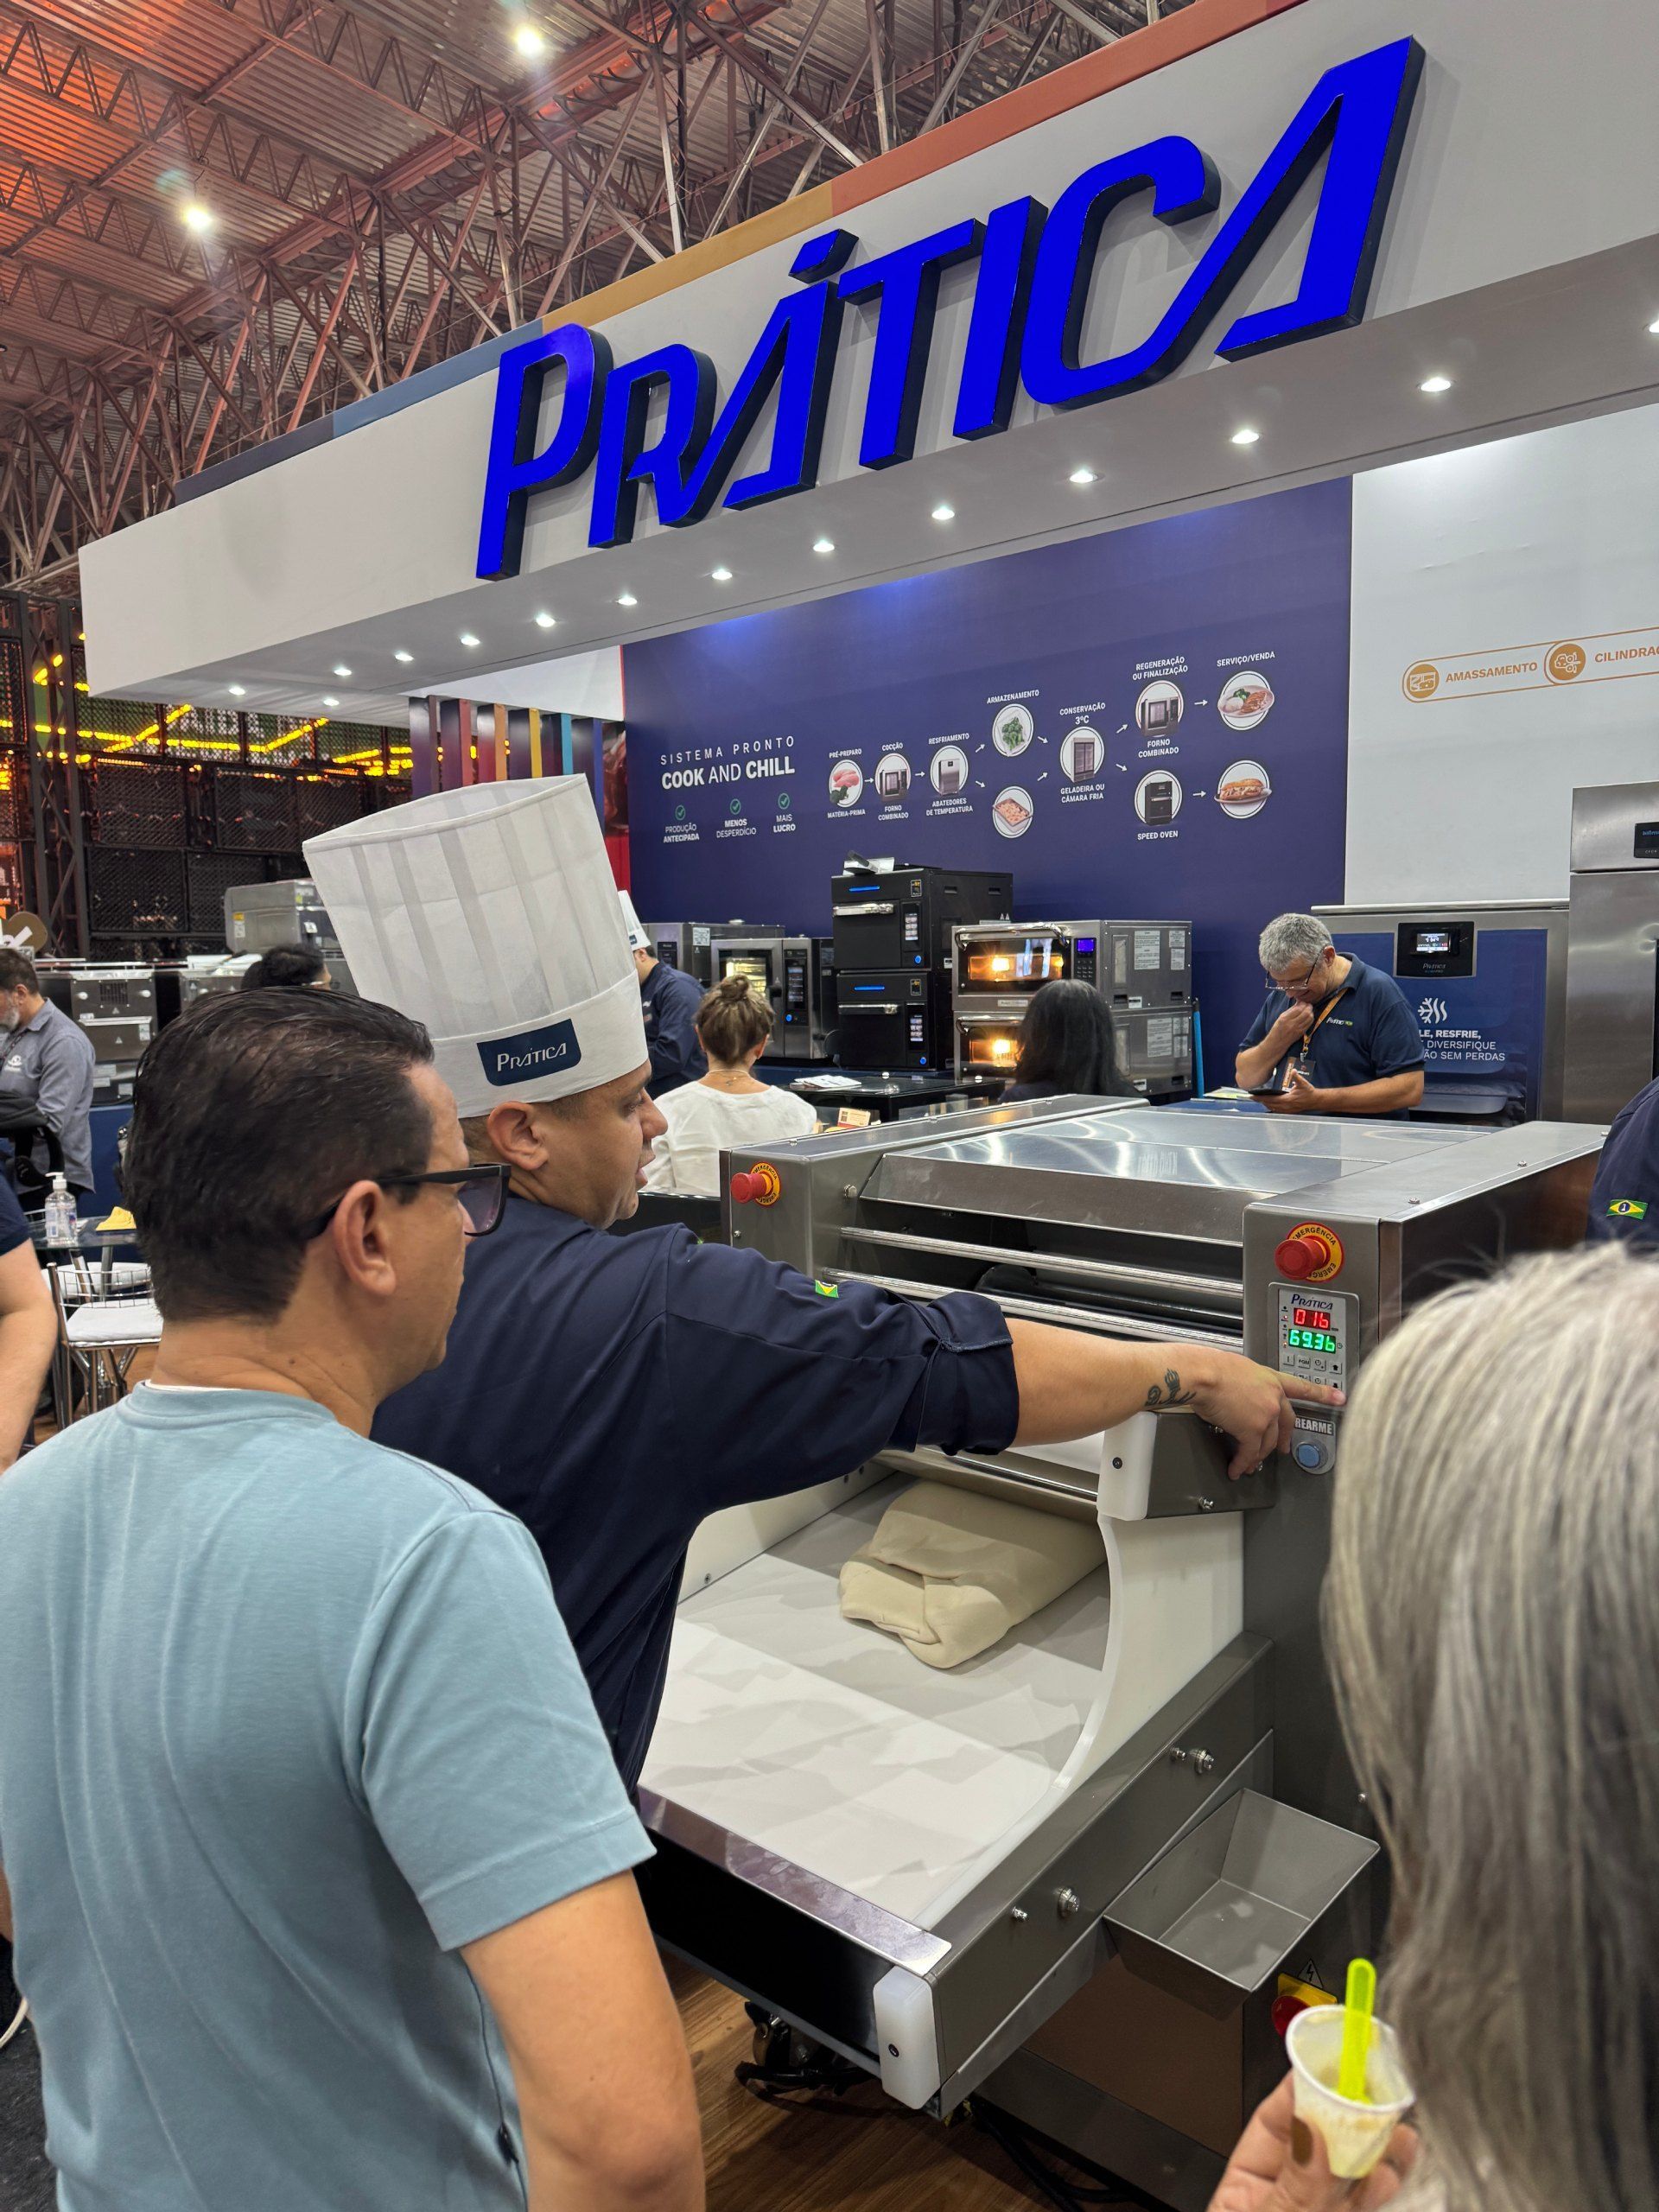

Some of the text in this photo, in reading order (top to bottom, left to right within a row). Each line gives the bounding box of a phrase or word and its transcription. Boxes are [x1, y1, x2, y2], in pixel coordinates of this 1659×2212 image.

[1135, 656, 1185, 671] REGENERAÇÃO
[1217, 651, 1275, 667] SERVIÇO/VENDA
[1143, 664, 1188, 679] FINALIZAÇÃO
[1445, 662, 1538, 683] AMASSAMENTO
[986, 689, 1039, 704] ARMAZENAMENTO
[1059, 702, 1106, 715] CONSERVAÇÃO
[928, 732, 970, 745] RESFRIAMENTO
[1147, 738, 1171, 748] FORNO
[660, 735, 794, 766] SISTEMA PRONTO
[881, 741, 903, 752] COCÇÃO
[829, 748, 862, 759] PRÉ-PREPARO
[1138, 747, 1179, 758] COMBINADO
[661, 756, 796, 790] COOK AND CHILL
[1060, 785, 1095, 795] GELADEIRA
[931, 798, 967, 808] ABATEDORES
[1061, 792, 1104, 804] CÂMARA FRIA
[827, 808, 866, 819] MATÉRIA-PRIMA
[878, 812, 909, 821] COMBINADO
[926, 805, 973, 817] DE TEMPERATURA
[724, 818, 747, 828] MENOS
[776, 814, 793, 823] MAIS
[664, 823, 697, 833] PRODUÇÃO
[716, 827, 757, 839] DESPERDÍCIO
[772, 823, 796, 833] LUCRO
[663, 833, 700, 843] ANTECIPADA
[1137, 830, 1179, 841] SPEED OVEN
[1435, 1029, 1482, 1039] RESFRIE,
[1427, 1040, 1497, 1052] DIVERSIFIQUE
[1440, 1051, 1462, 1060] SEM
[1465, 1052, 1505, 1062] PERDAS
[1294, 1416, 1332, 1435] REARME
